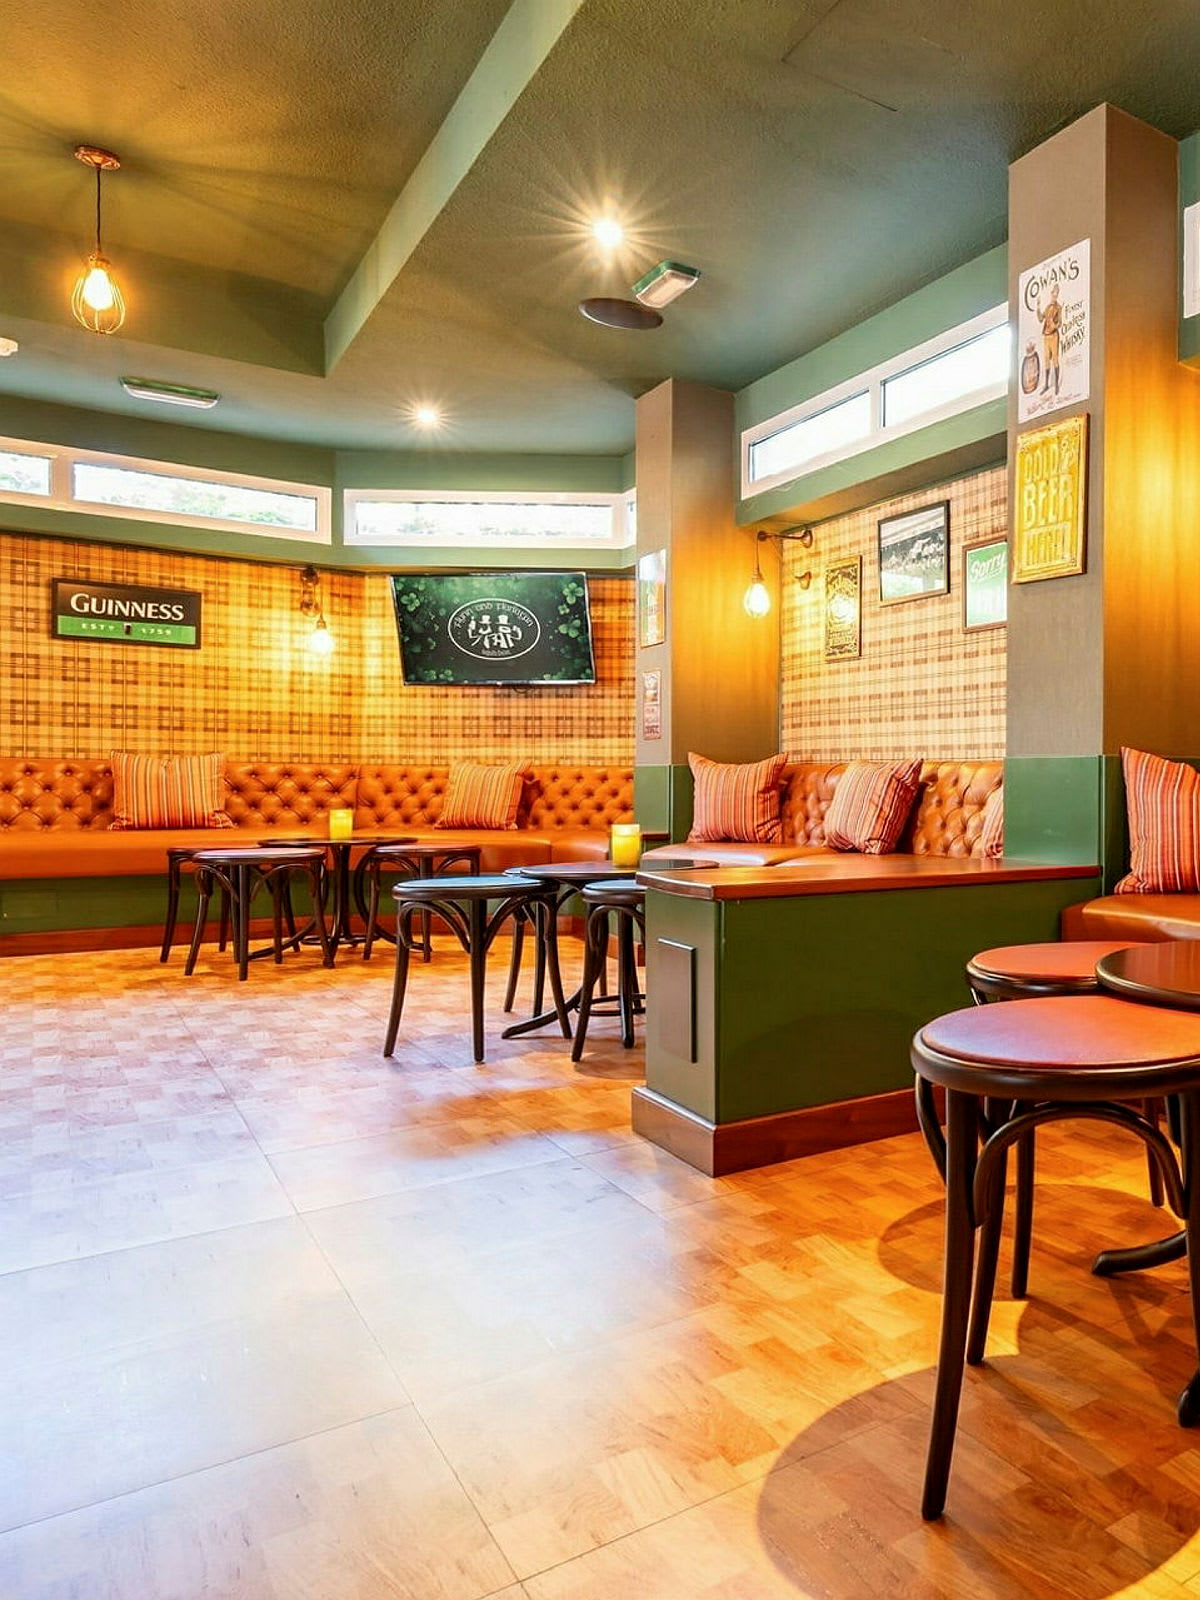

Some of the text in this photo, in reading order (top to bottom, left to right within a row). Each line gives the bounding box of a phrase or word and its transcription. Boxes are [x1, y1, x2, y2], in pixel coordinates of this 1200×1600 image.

[1024, 257, 1080, 312] COWAN'S
[1023, 473, 1073, 530] BEER
[70, 593, 185, 621] GUINNESS
